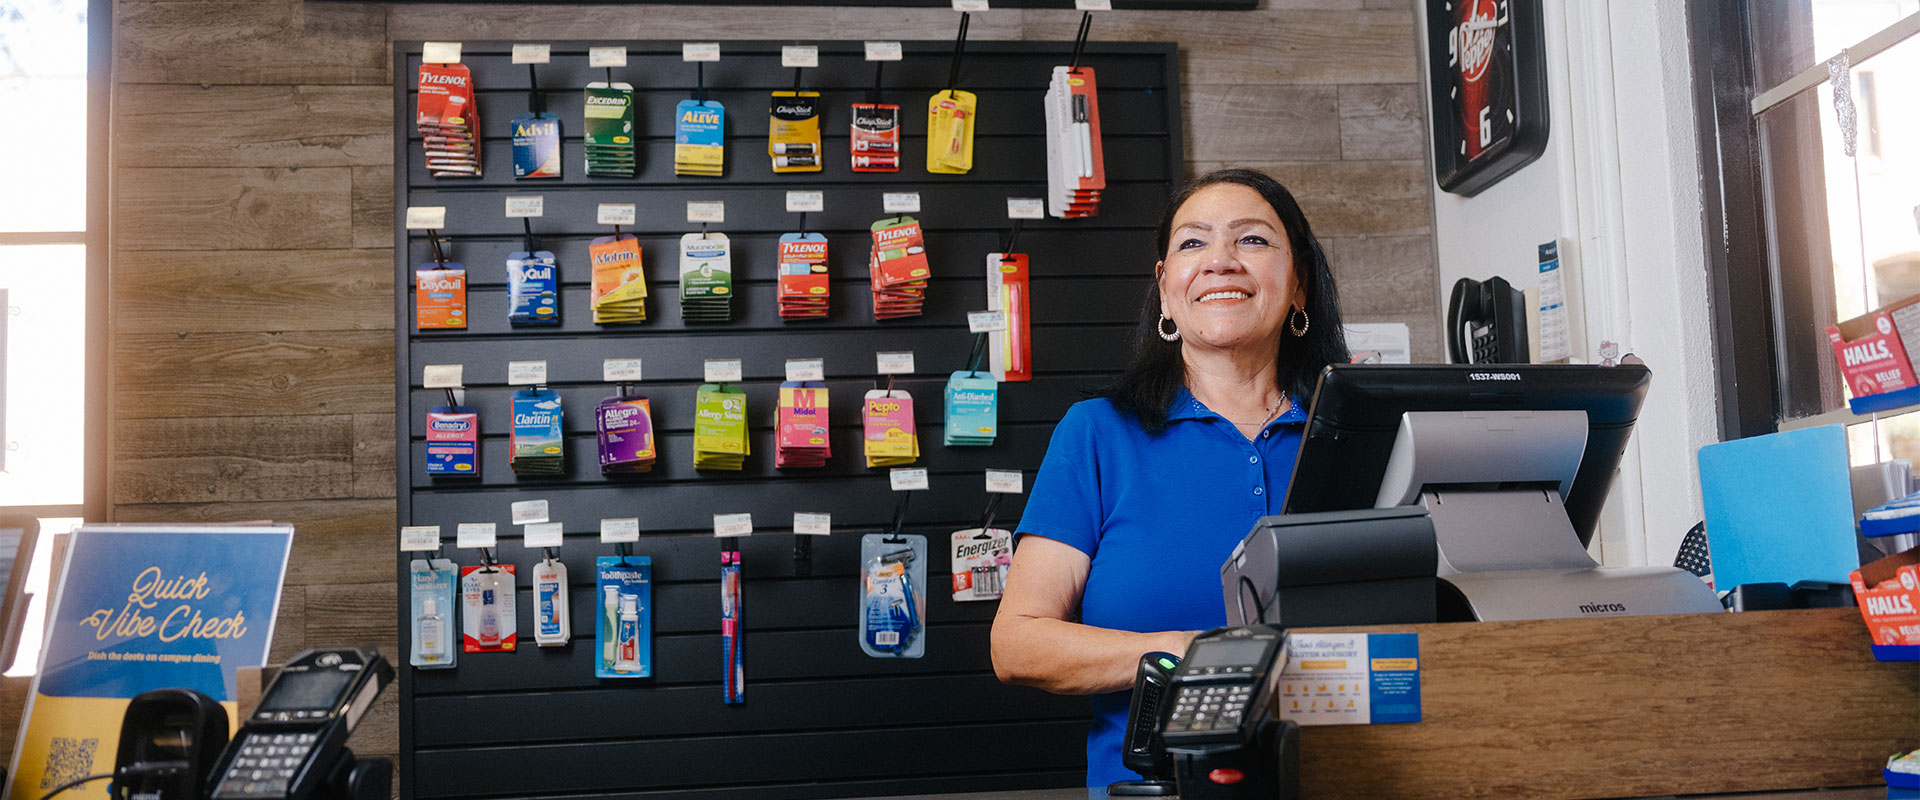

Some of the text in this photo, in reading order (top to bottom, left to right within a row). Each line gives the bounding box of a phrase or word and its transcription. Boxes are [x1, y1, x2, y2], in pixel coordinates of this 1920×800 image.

[1449, 26, 1458, 67] 9
[421, 72, 467, 86] TYLENOL
[587, 96, 627, 105] EXCEDRIN
[776, 105, 812, 115] ChapStick
[681, 111, 719, 124] ALEVE
[856, 117, 893, 127] ChapStick
[515, 123, 554, 137] Advil
[1480, 105, 1491, 148] 6
[876, 226, 917, 242] TYLENOL
[783, 242, 825, 253] TYLENOL
[595, 250, 634, 264] Motrin
[420, 279, 461, 292] DayQuil
[1470, 373, 1521, 381] 1537-WS001
[1875, 368, 1901, 383] RELIEF
[605, 408, 638, 418] Allegra
[869, 401, 900, 413] Pepto
[515, 413, 550, 425] Claritin
[698, 409, 742, 420] Allergy Sinus
[434, 421, 467, 430] Benadryl
[957, 536, 1008, 558] Energizer
[600, 571, 642, 581] Toothpaste
[957, 574, 966, 582] 12
[128, 567, 210, 608] Quick
[880, 584, 887, 594] 3
[1579, 602, 1626, 613] micros
[80, 603, 247, 642] Vibe Check
[88, 651, 106, 660] Dish
[108, 652, 122, 660] the
[159, 654, 191, 664] campus
[193, 653, 221, 664] dining
